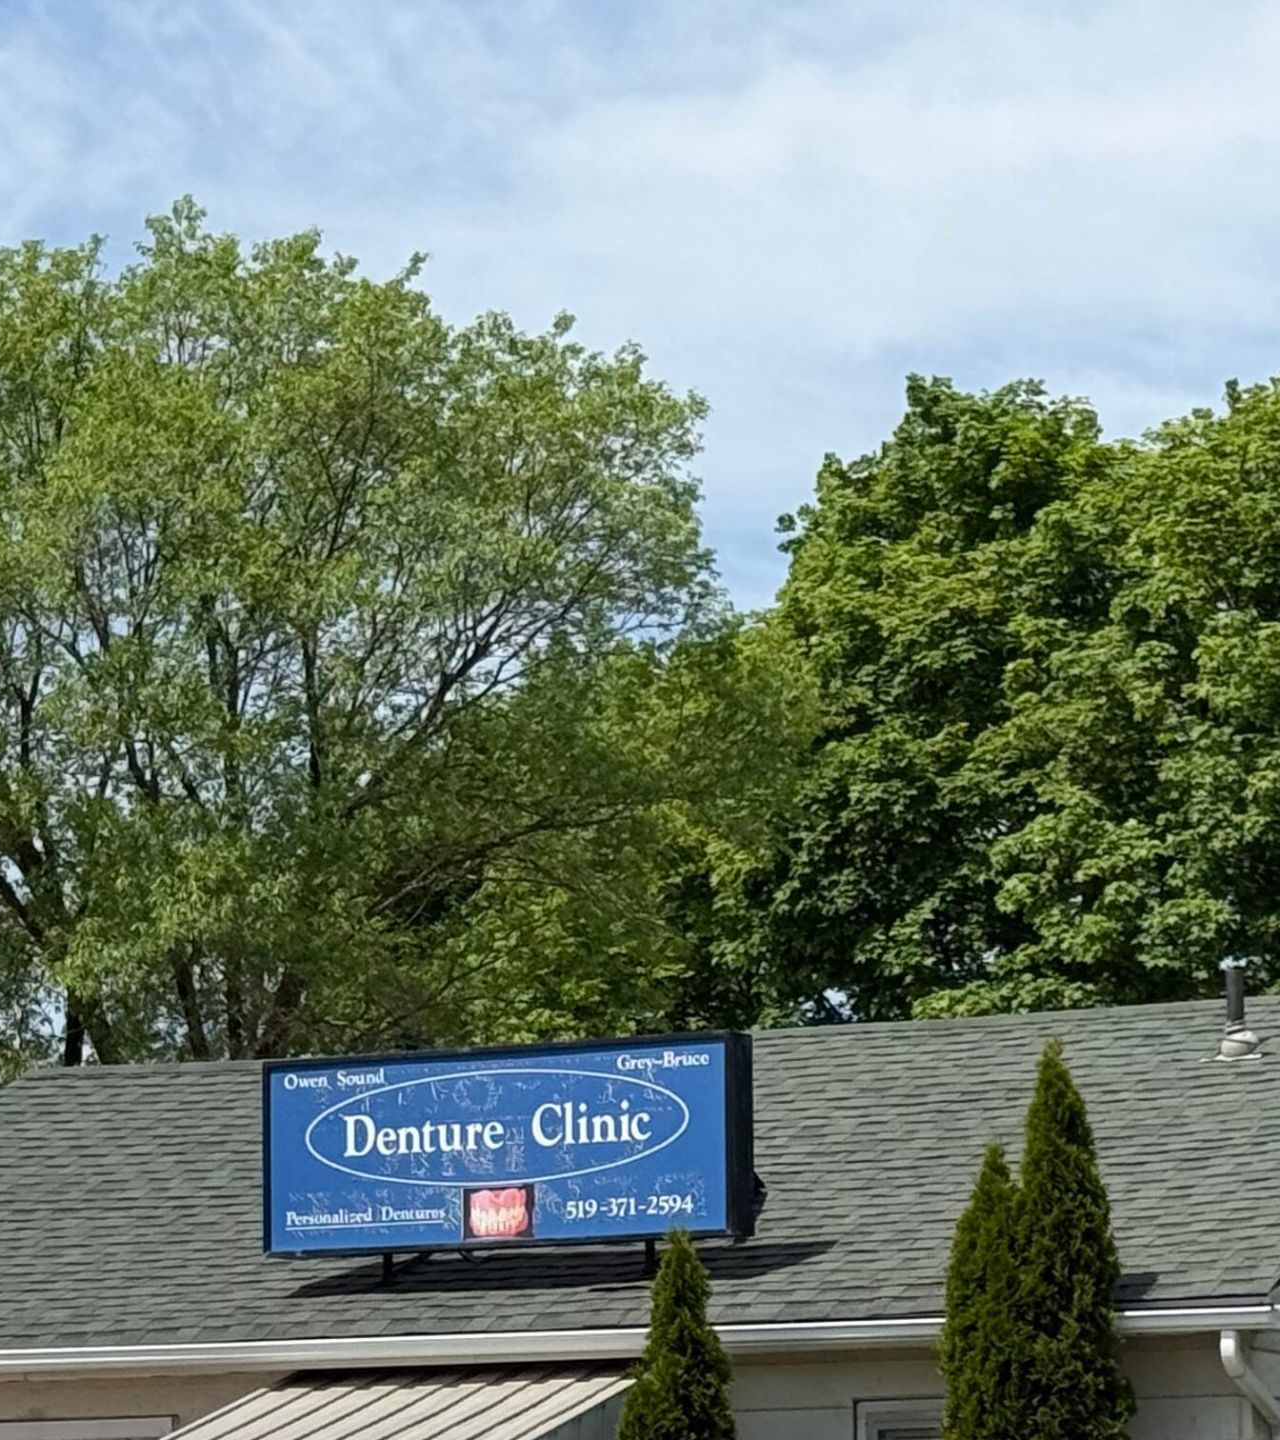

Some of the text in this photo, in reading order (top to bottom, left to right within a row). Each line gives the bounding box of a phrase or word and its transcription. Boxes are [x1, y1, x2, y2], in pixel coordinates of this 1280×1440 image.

[616, 1050, 710, 1073] Grey-Bruce
[283, 1067, 385, 1090] Owen Sound
[339, 1099, 653, 1158] Denture Clinic
[285, 1205, 446, 1226] Personalized Dentures
[566, 1194, 695, 1219] 519-371-2594
